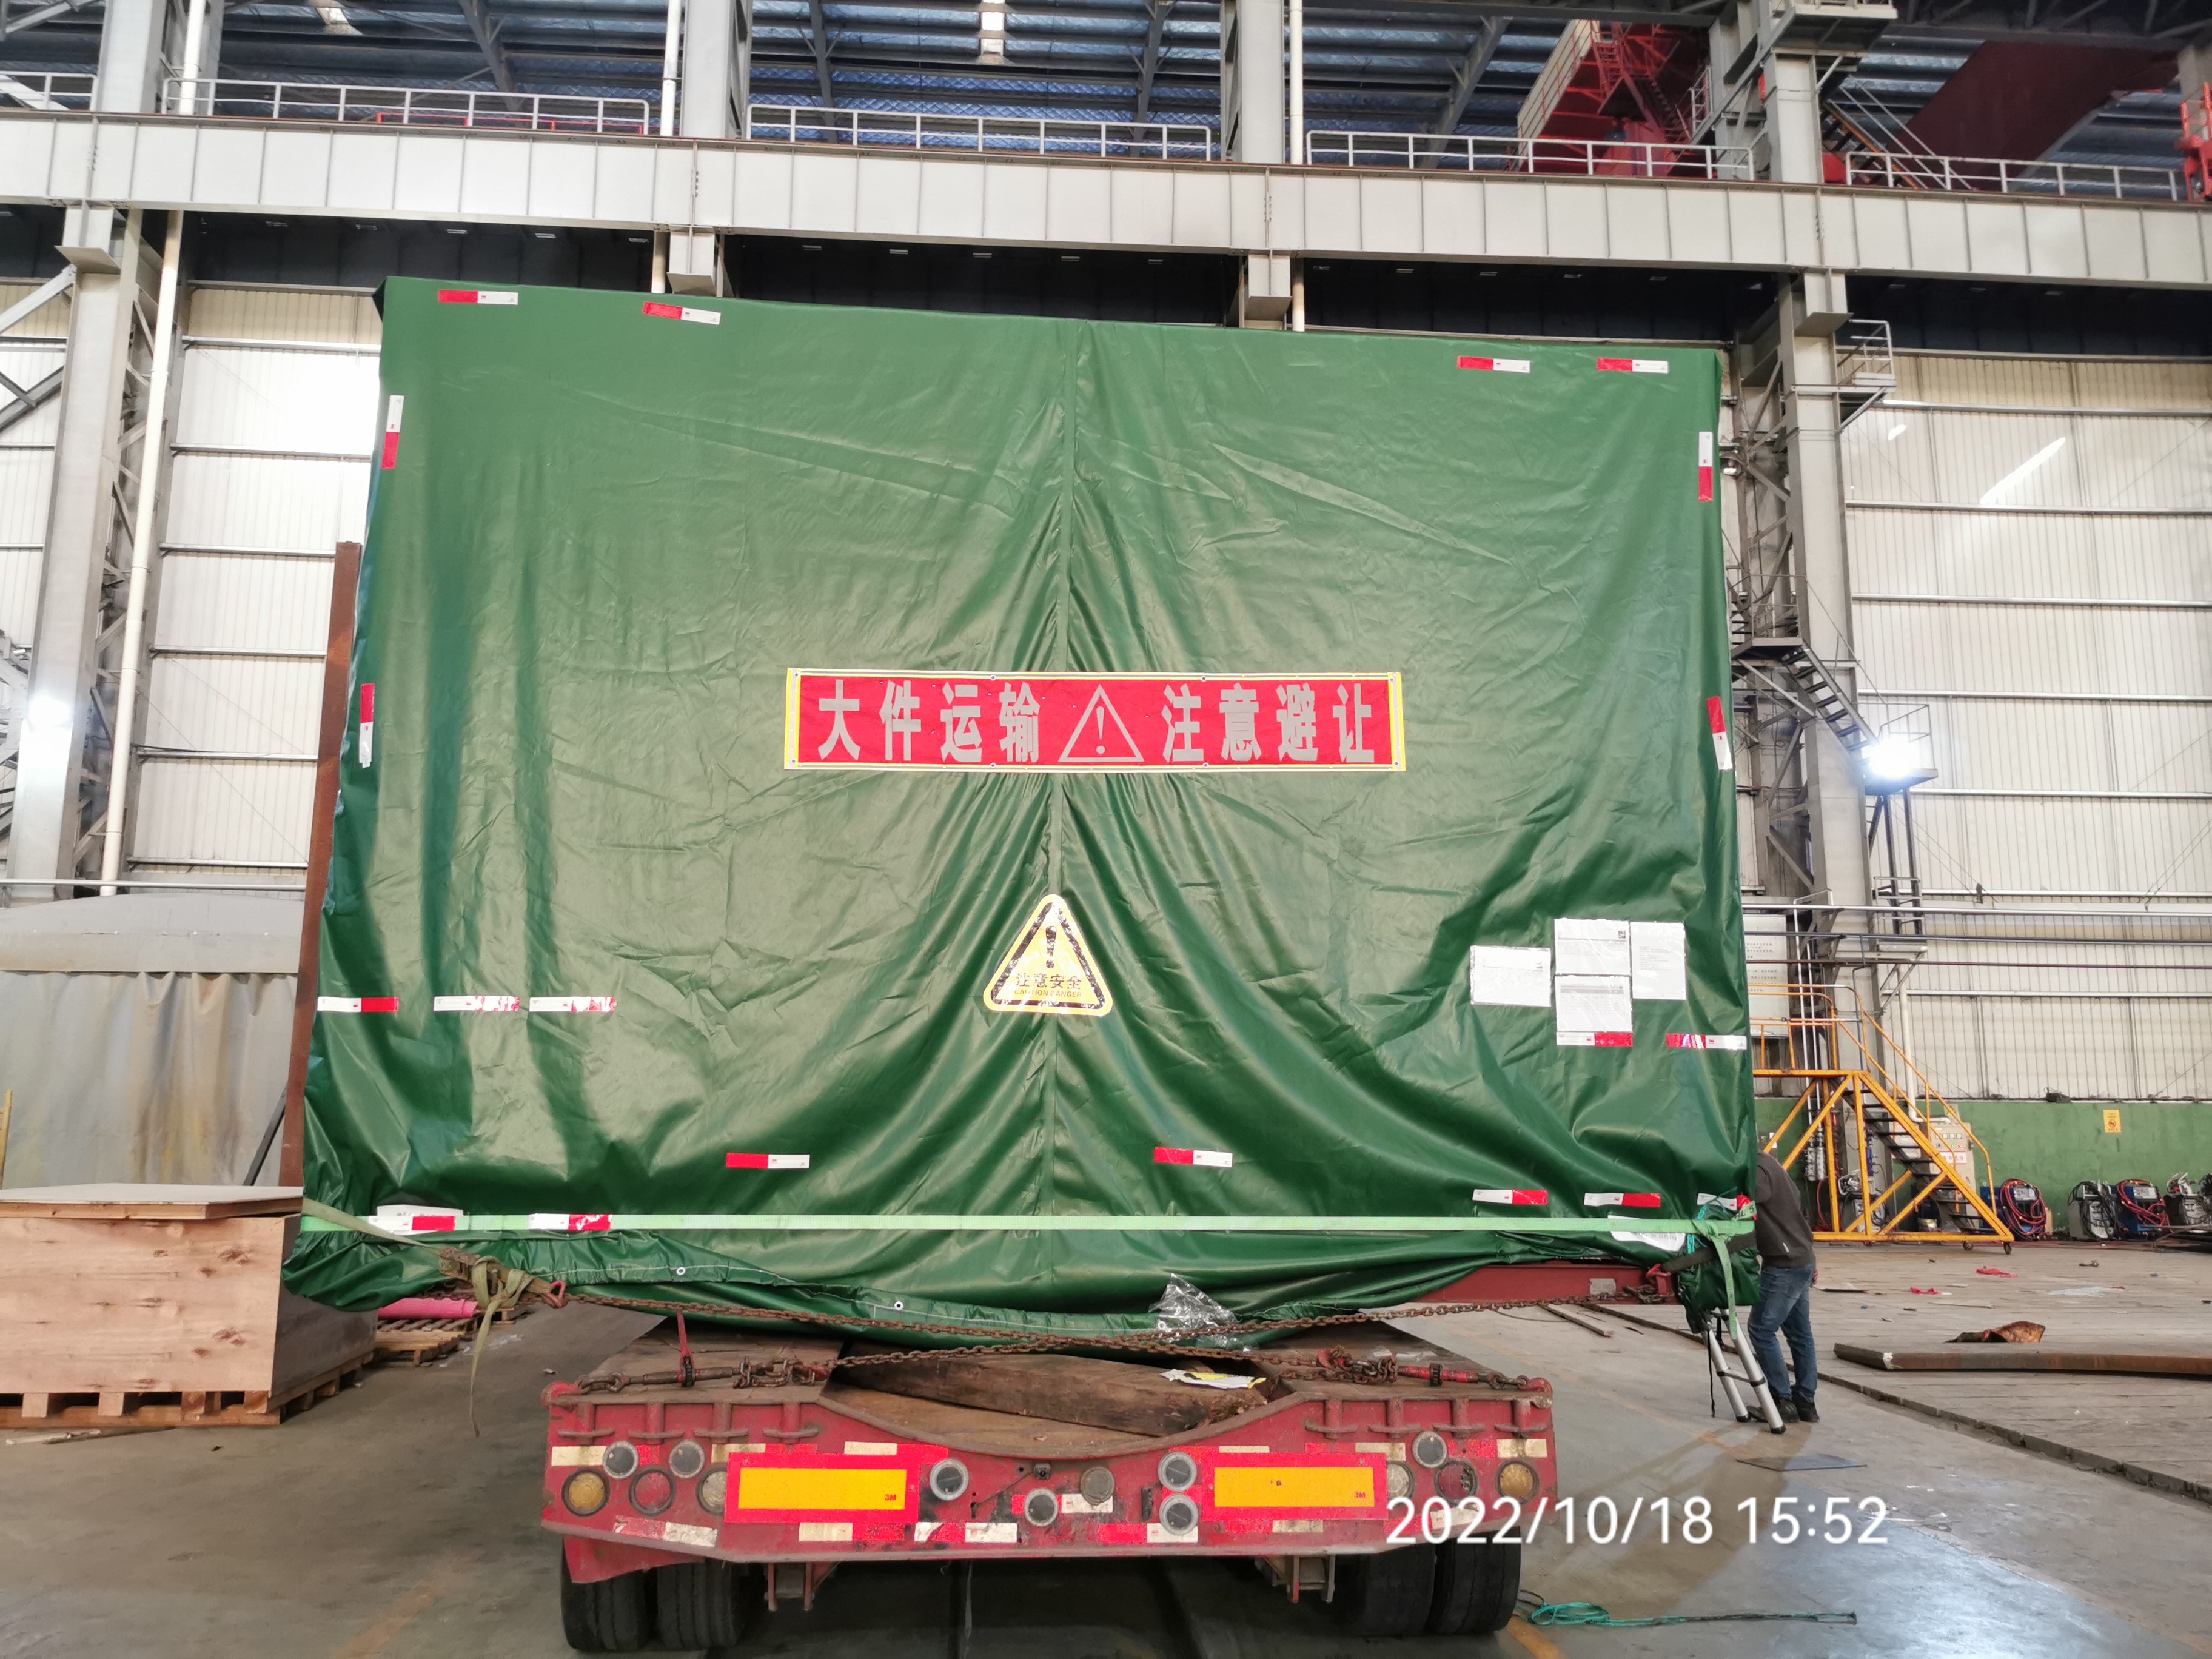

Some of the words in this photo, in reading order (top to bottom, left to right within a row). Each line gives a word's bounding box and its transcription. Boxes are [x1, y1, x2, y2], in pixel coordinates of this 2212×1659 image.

[818, 679, 1040, 762] 大件运输
[1161, 682, 1374, 763] 注意避让
[1016, 972, 1082, 990] 注意安全
